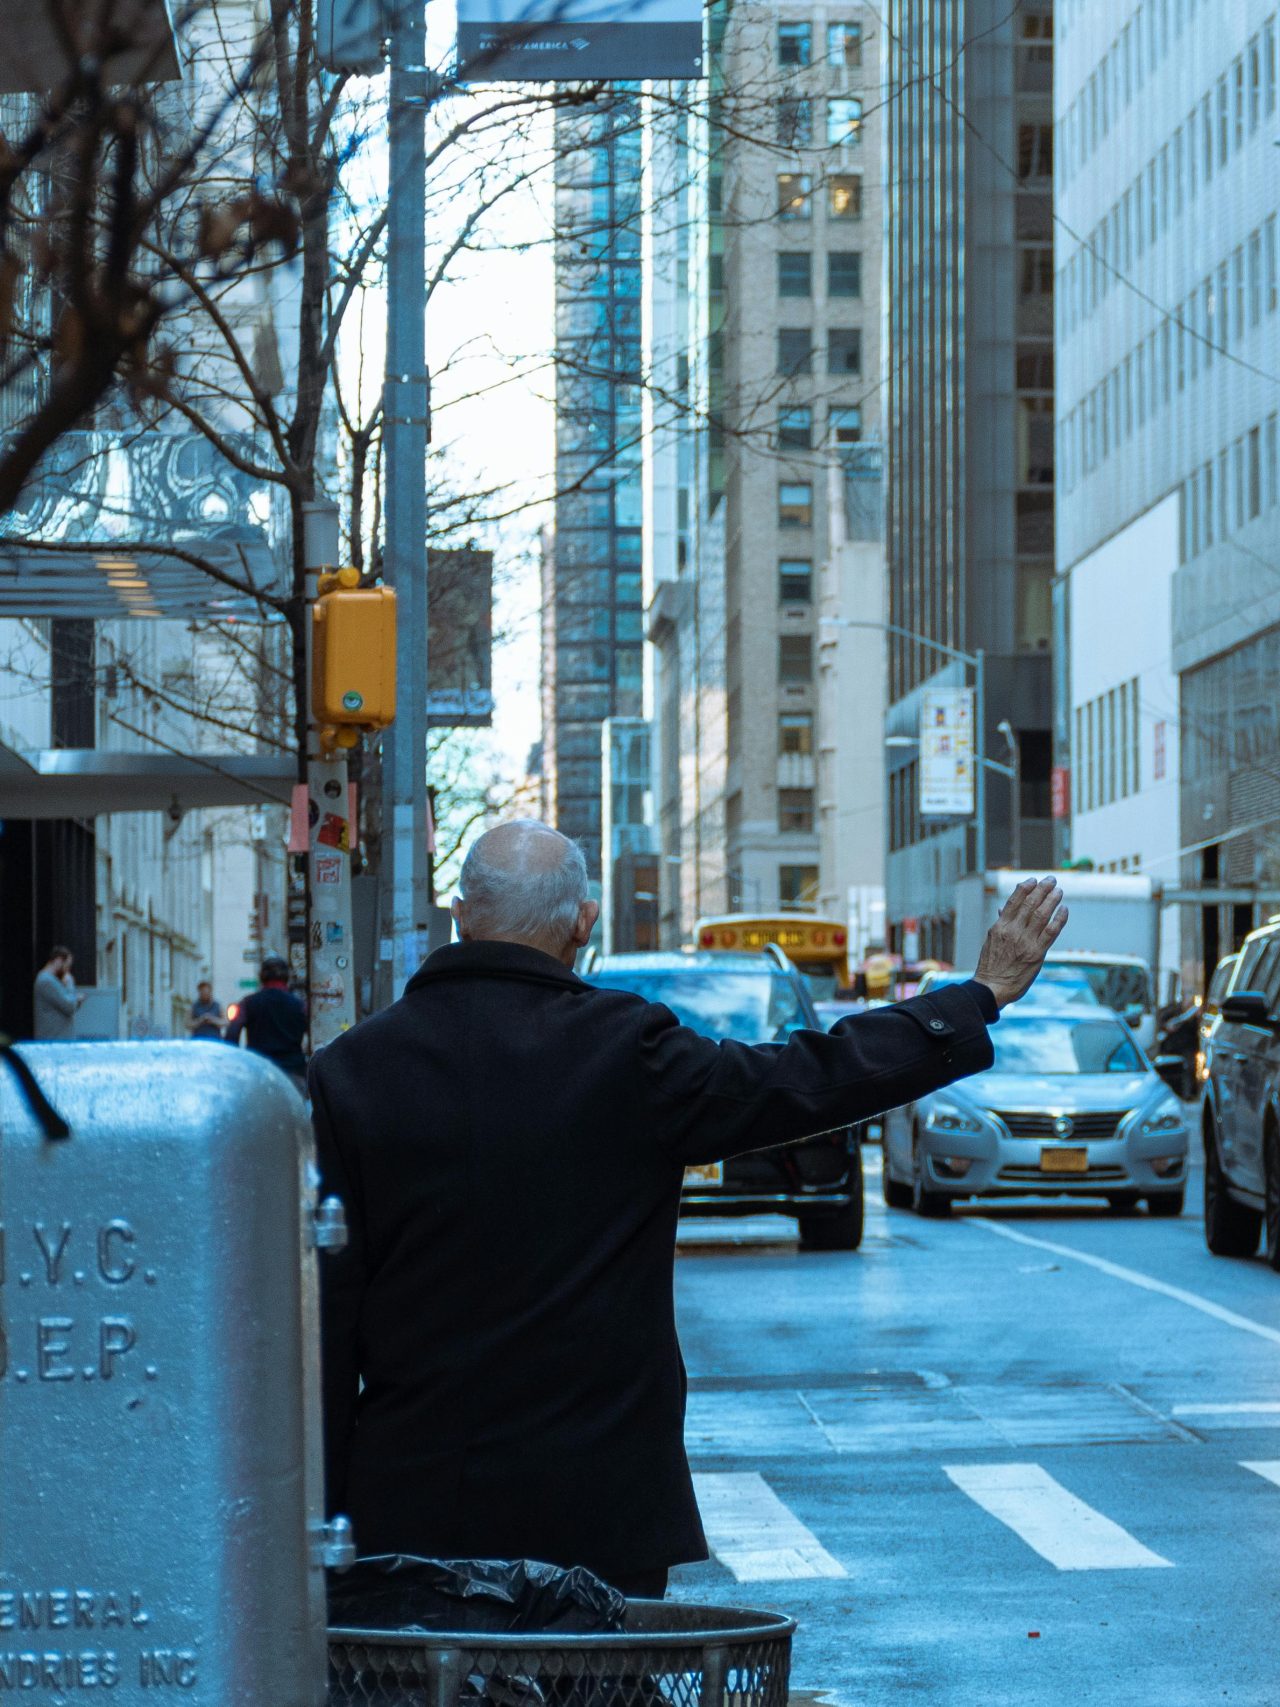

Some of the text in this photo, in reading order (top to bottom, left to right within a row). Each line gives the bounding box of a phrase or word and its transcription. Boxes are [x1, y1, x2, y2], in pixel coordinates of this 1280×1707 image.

[523, 41, 569, 50] AMERICA
[0, 1217, 156, 1288] .Y.C.
[0, 1315, 157, 1382] .E.P.
[139, 1650, 197, 1688] INC
